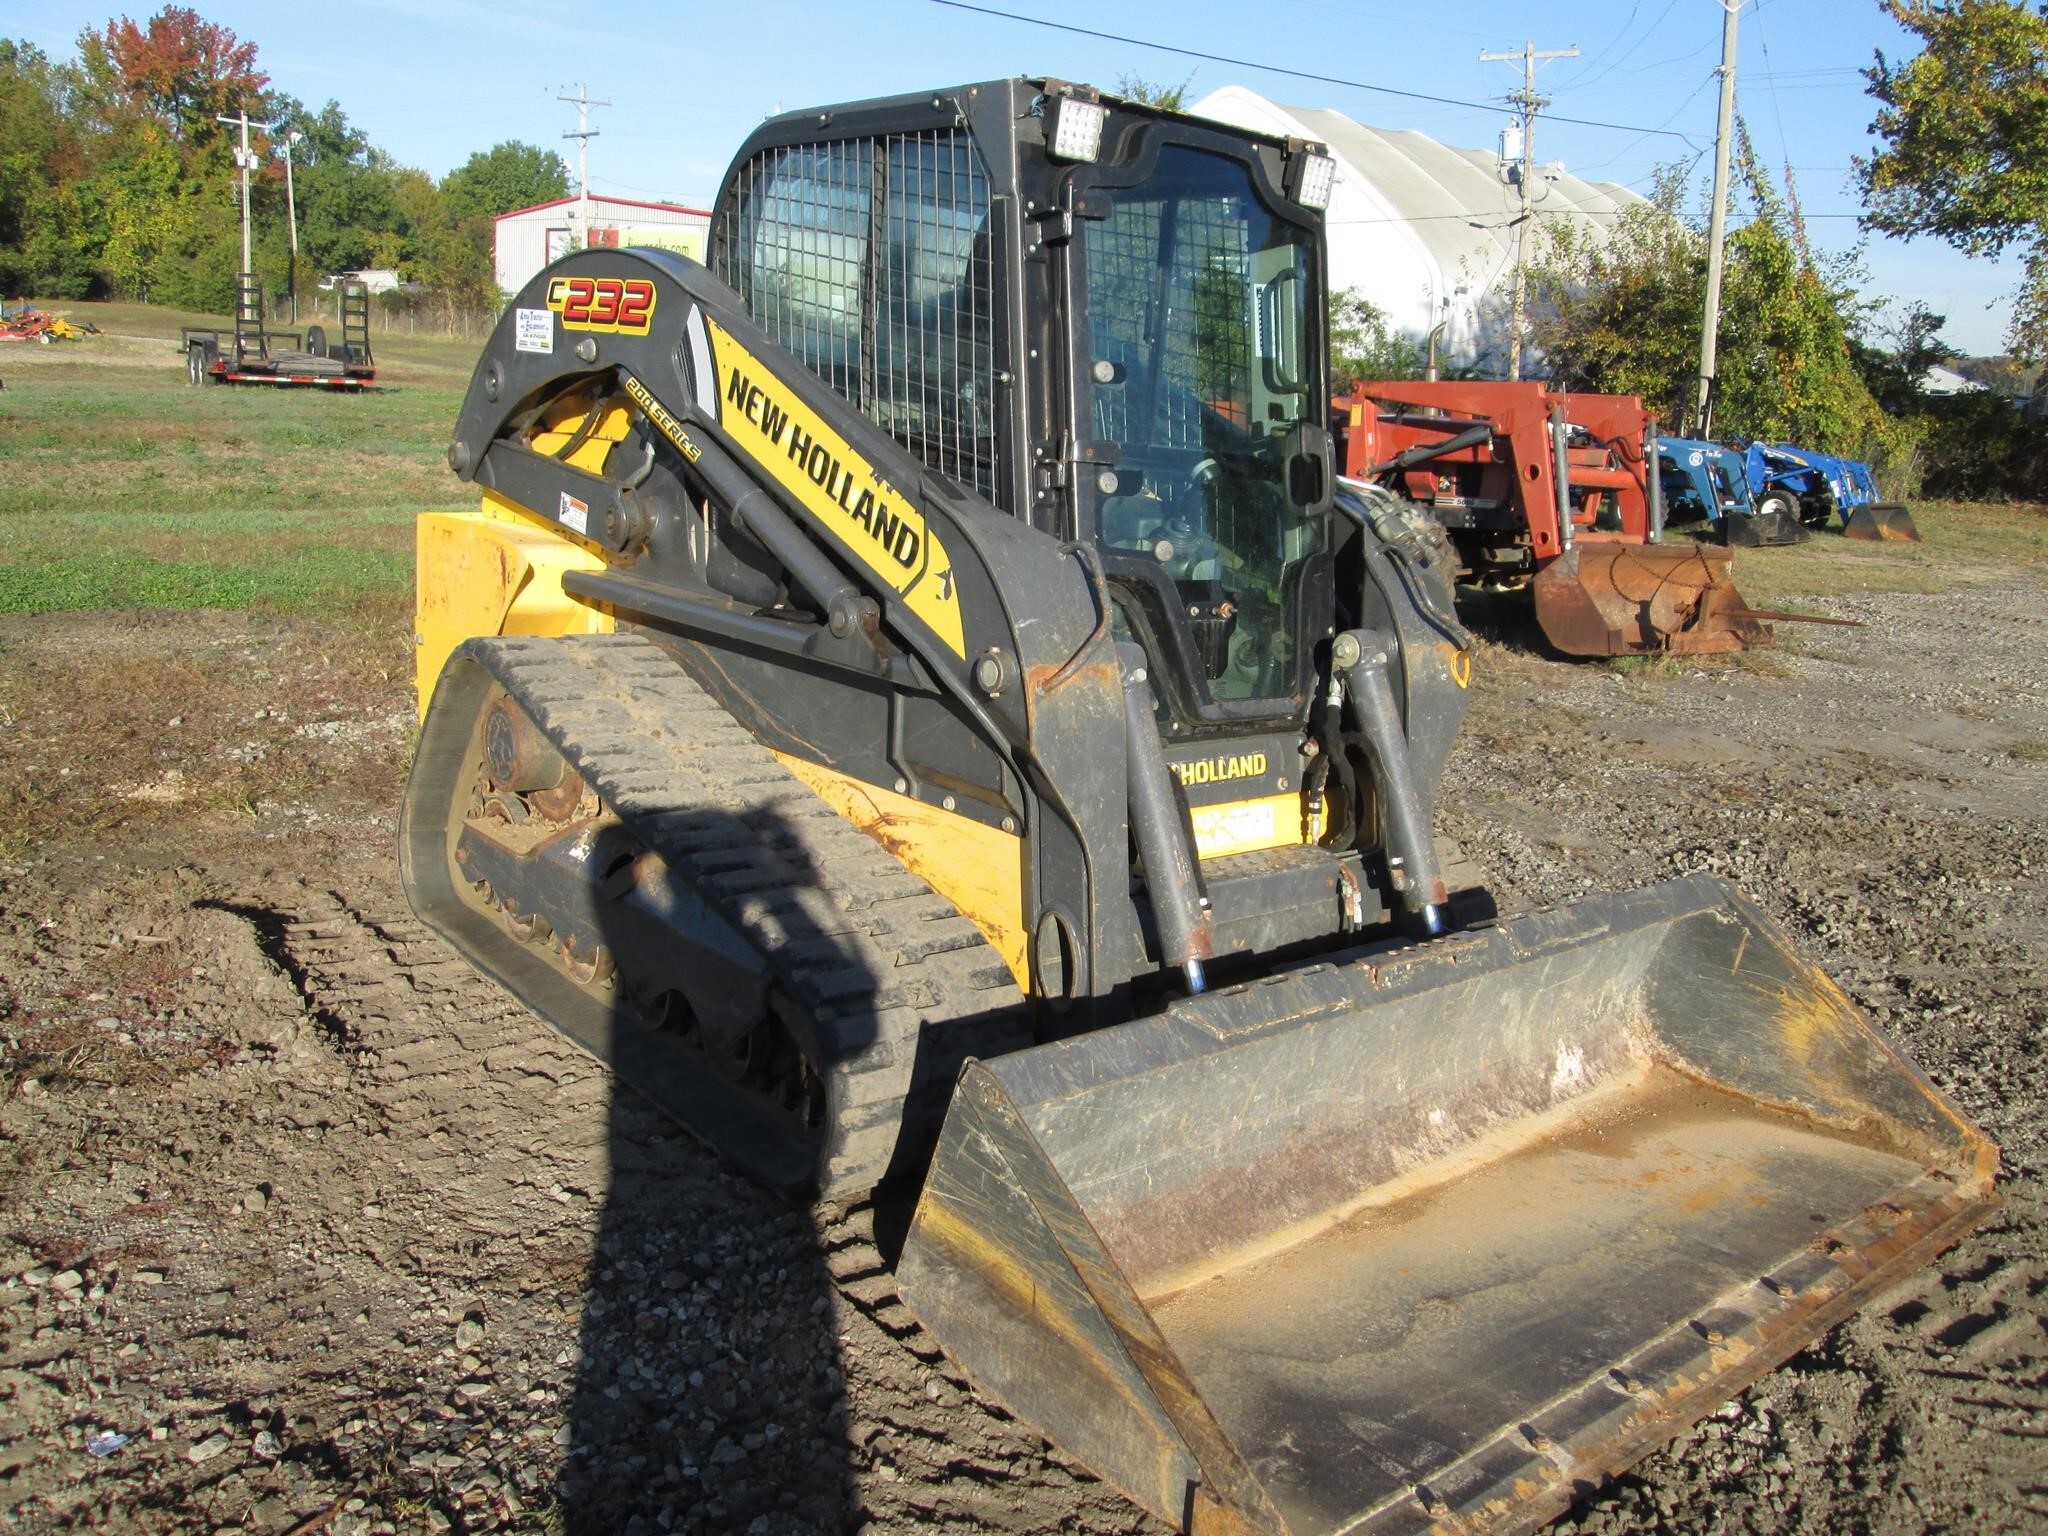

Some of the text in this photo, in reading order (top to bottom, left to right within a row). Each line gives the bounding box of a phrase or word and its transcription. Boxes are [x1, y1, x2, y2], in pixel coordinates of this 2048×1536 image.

[548, 280, 654, 327] C232
[626, 379, 700, 456] 200 SERIES
[727, 367, 920, 570] NEW HOLLAND
[1180, 753, 1267, 786] HOLLAND
